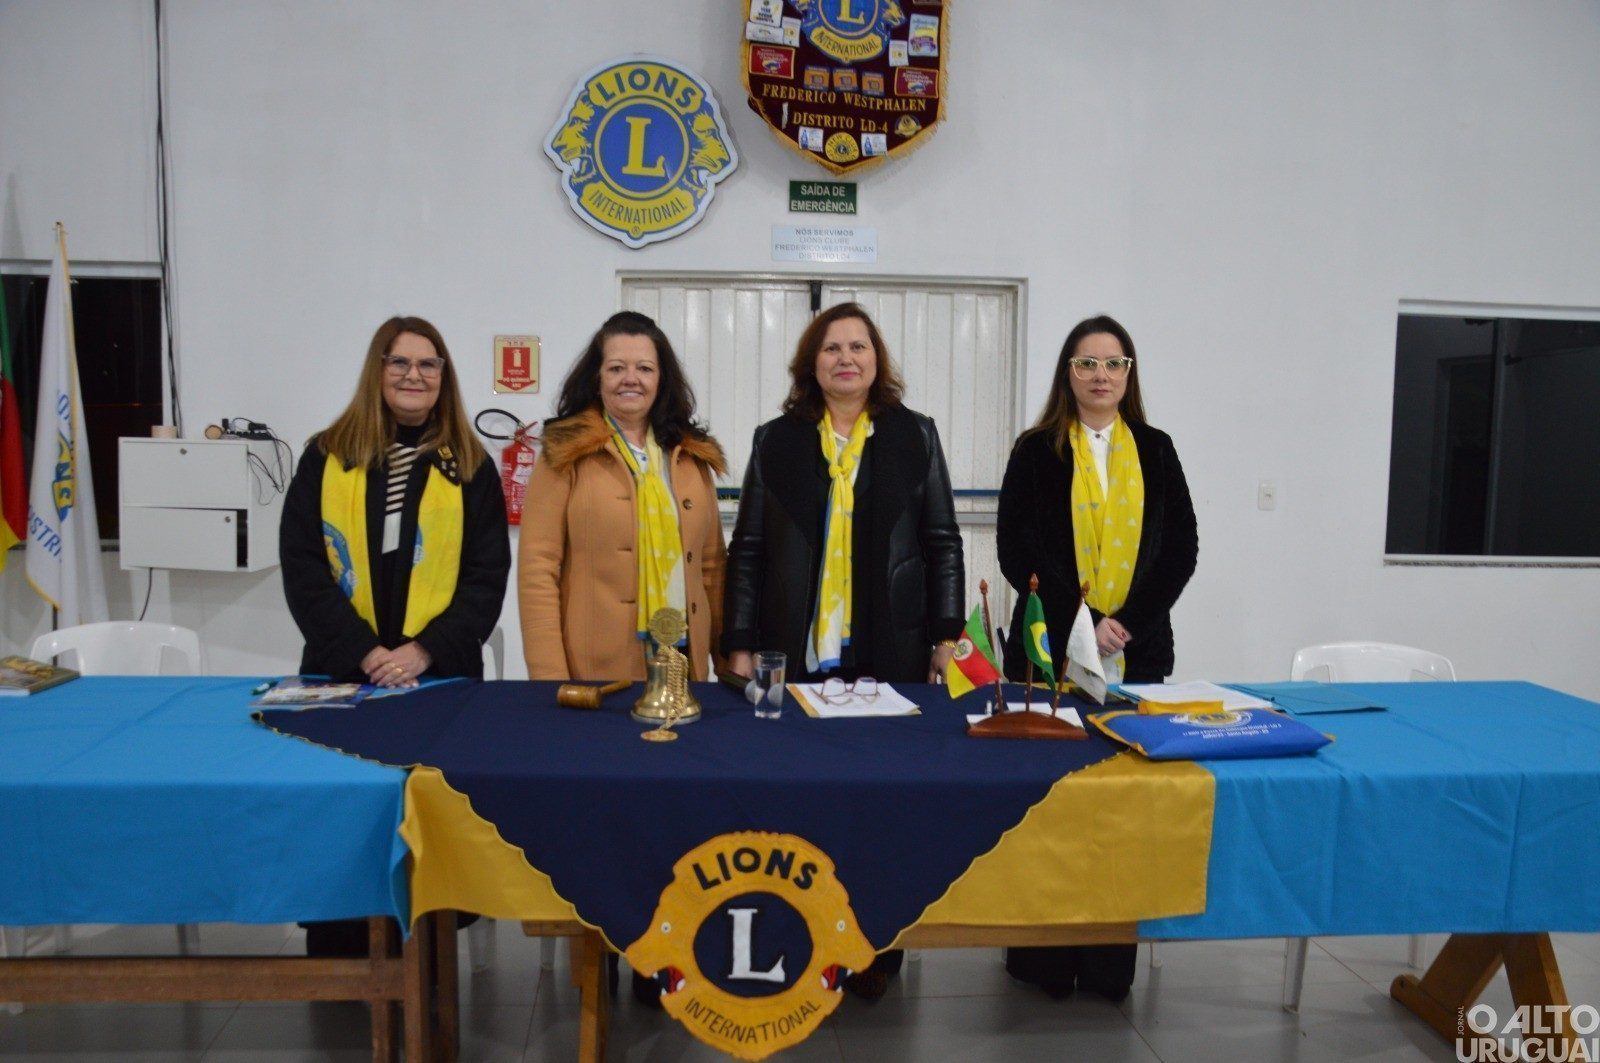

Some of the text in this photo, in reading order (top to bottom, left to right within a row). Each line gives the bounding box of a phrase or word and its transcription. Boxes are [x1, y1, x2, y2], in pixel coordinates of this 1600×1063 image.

[817, 31, 879, 56] INTERNATIONAL
[596, 68, 697, 108] LIONS
[763, 84, 926, 110] FREDERICO WESTPHALEN
[793, 111, 889, 133] DISTRITO LD-4
[621, 116, 666, 177] L
[801, 183, 846, 197] SAÍDA DE
[588, 189, 687, 226] INTERNATIONAL
[791, 200, 855, 212] EMERGÊNCIA
[813, 229, 854, 237] SERVIMOS
[692, 847, 818, 890] LIONS
[727, 908, 786, 983] L
[684, 997, 822, 1044] INTERNATIONAL
